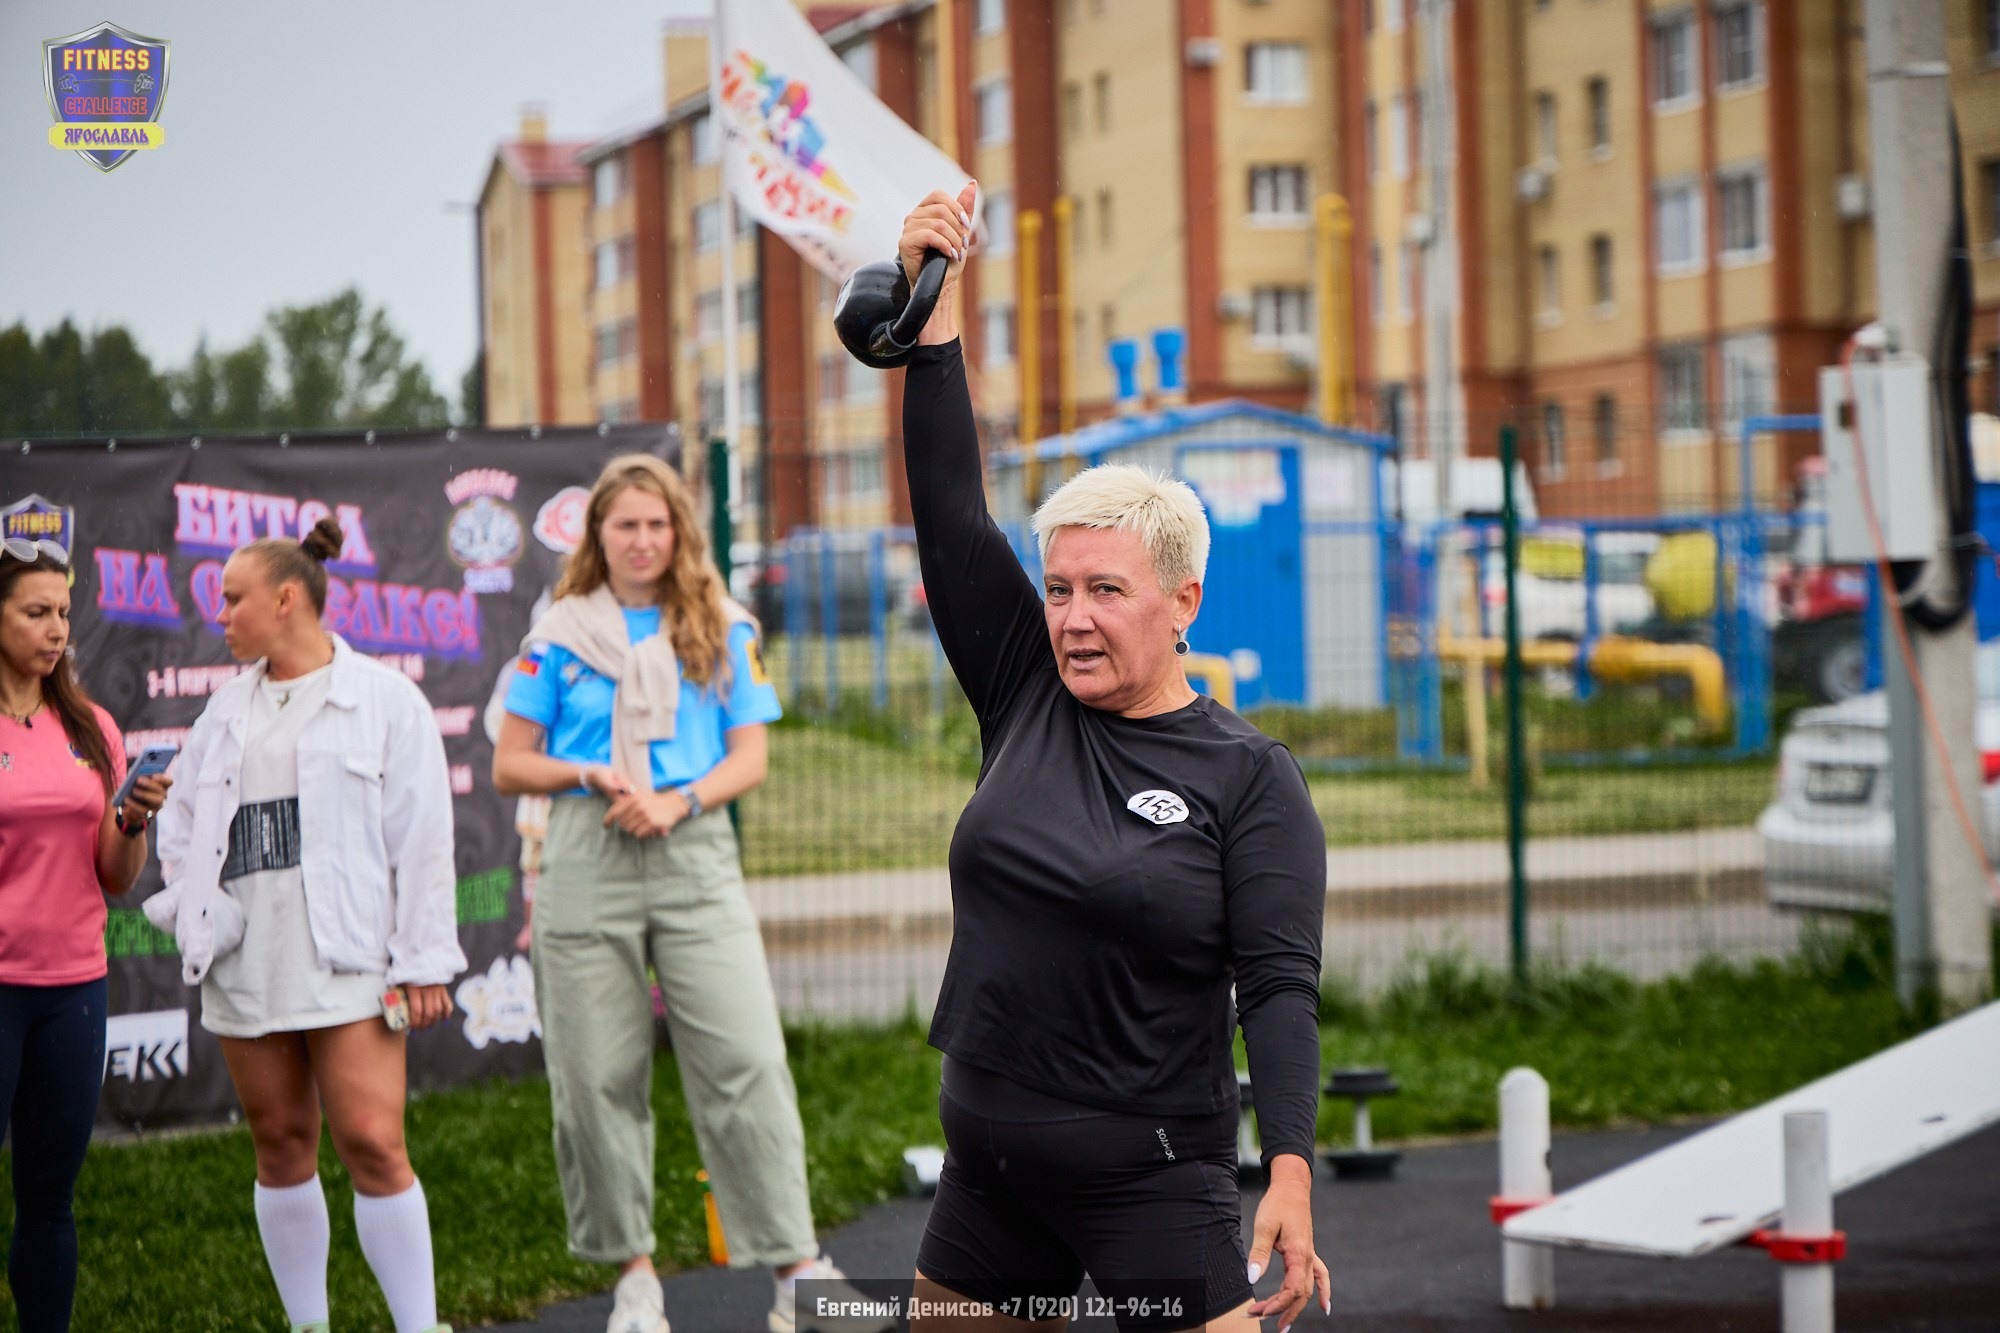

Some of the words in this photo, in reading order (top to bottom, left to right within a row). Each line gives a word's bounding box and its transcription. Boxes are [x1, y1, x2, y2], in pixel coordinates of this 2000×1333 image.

[93, 546, 179, 618] НА
[190, 559, 480, 654] СЕЛКЕ!
[1138, 795, 1183, 822] 155
[1155, 1127, 1176, 1161] DOMYOS
